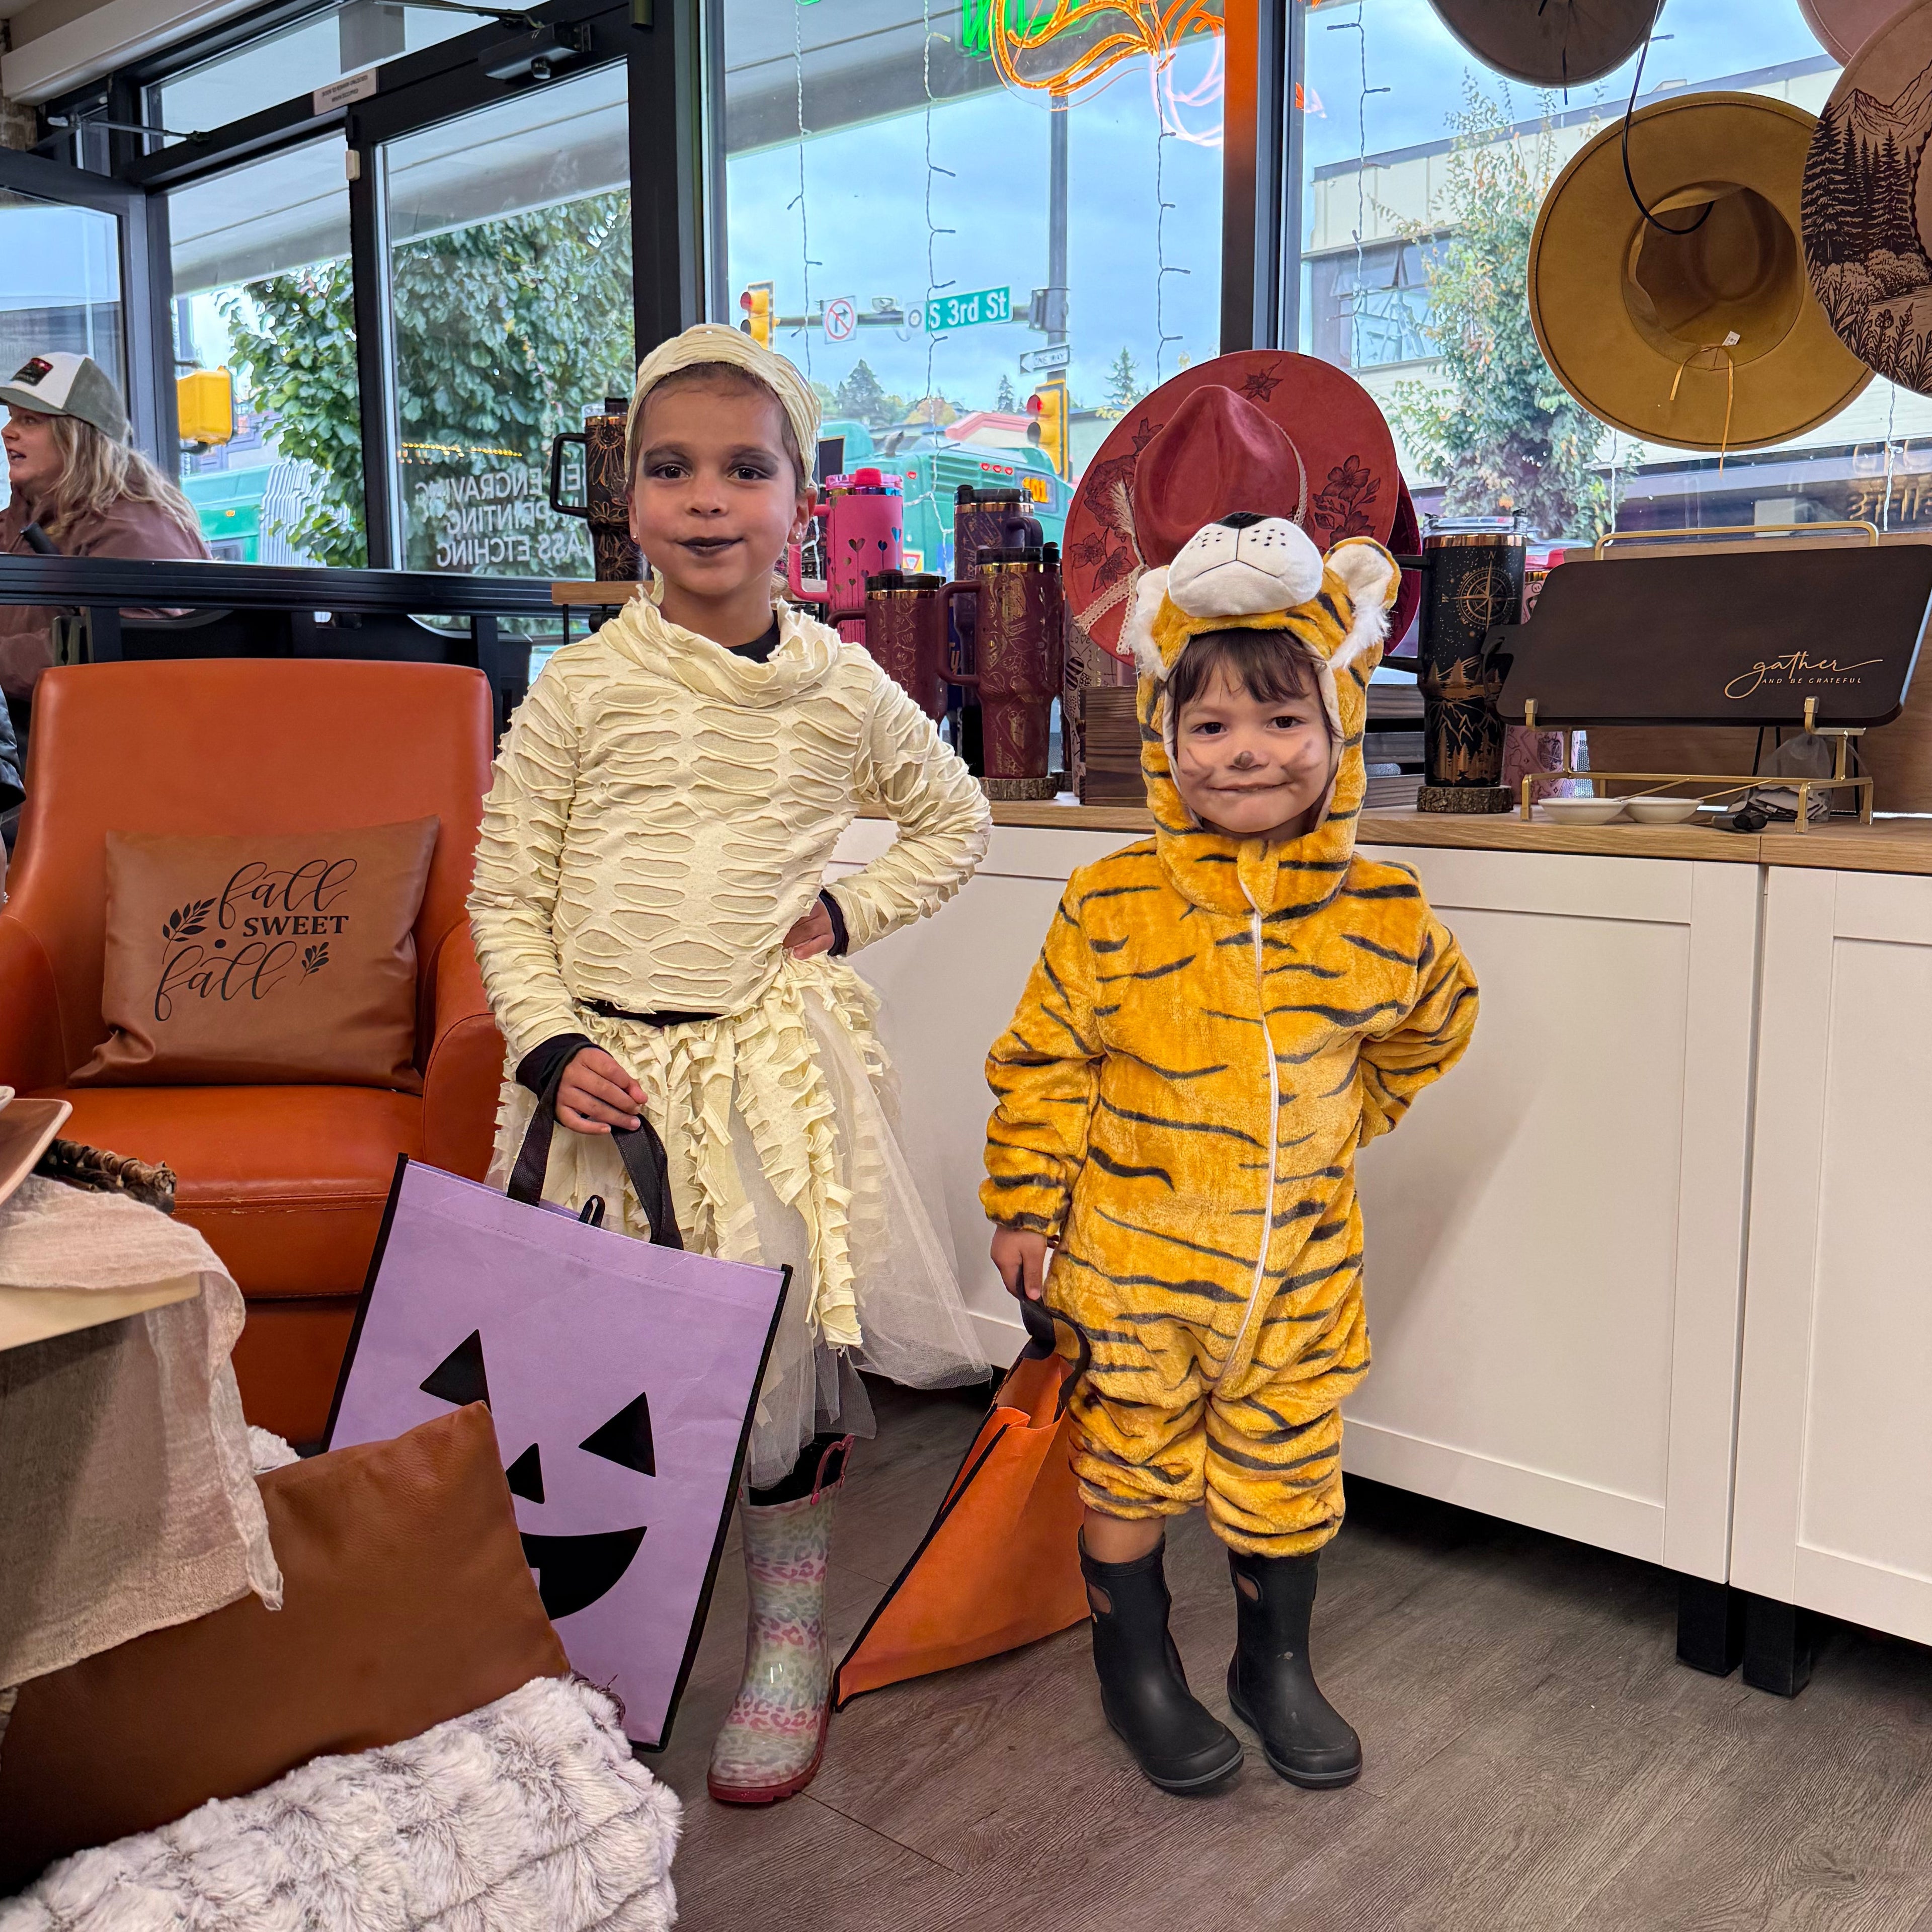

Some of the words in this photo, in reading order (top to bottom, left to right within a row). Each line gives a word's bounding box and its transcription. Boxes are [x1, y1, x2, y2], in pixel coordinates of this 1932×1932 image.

[929, 302, 940, 329] S
[947, 296, 979, 326] 3rd
[985, 290, 1007, 319] St
[1488, 551, 1496, 559] N
[1724, 651, 1884, 699] gather
[218, 858, 357, 930] fall
[243, 915, 349, 937] SWEET
[154, 941, 297, 1021] fall
